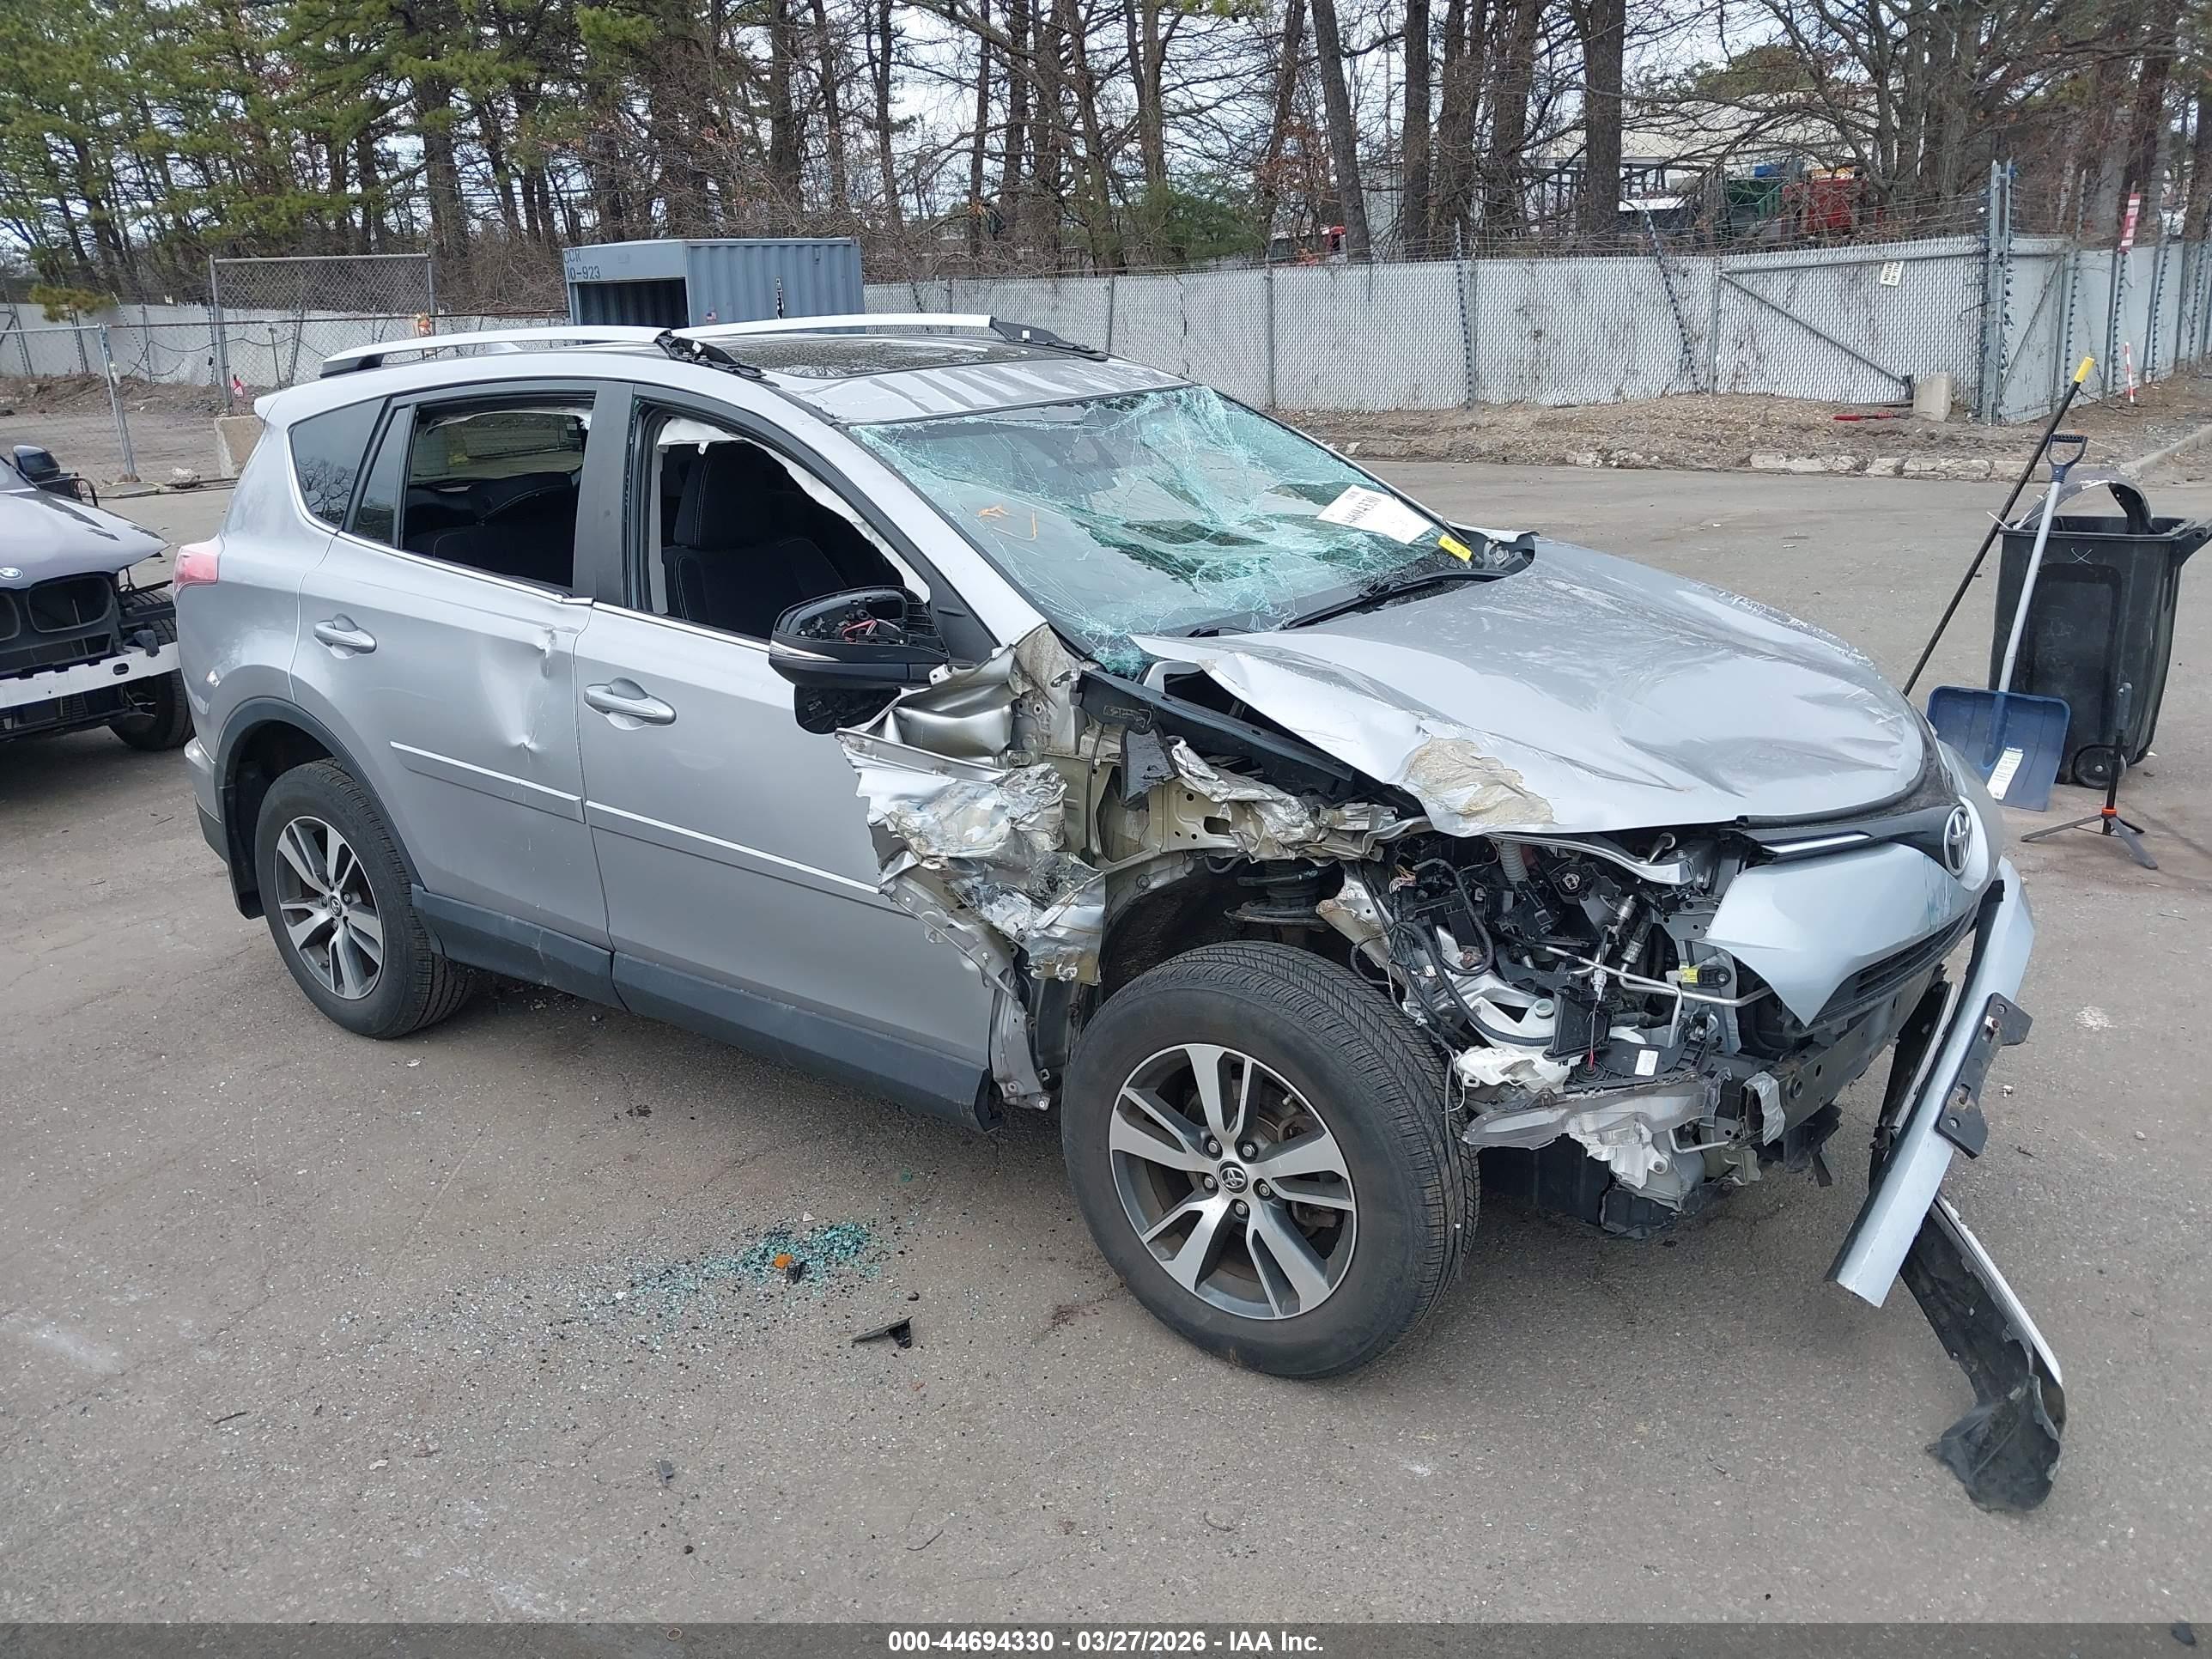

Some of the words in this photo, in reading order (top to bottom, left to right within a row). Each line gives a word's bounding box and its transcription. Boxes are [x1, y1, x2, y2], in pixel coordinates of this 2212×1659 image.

[562, 249, 581, 264] CCR
[567, 265, 601, 281] 10-923
[1883, 260, 1893, 281] TATION
